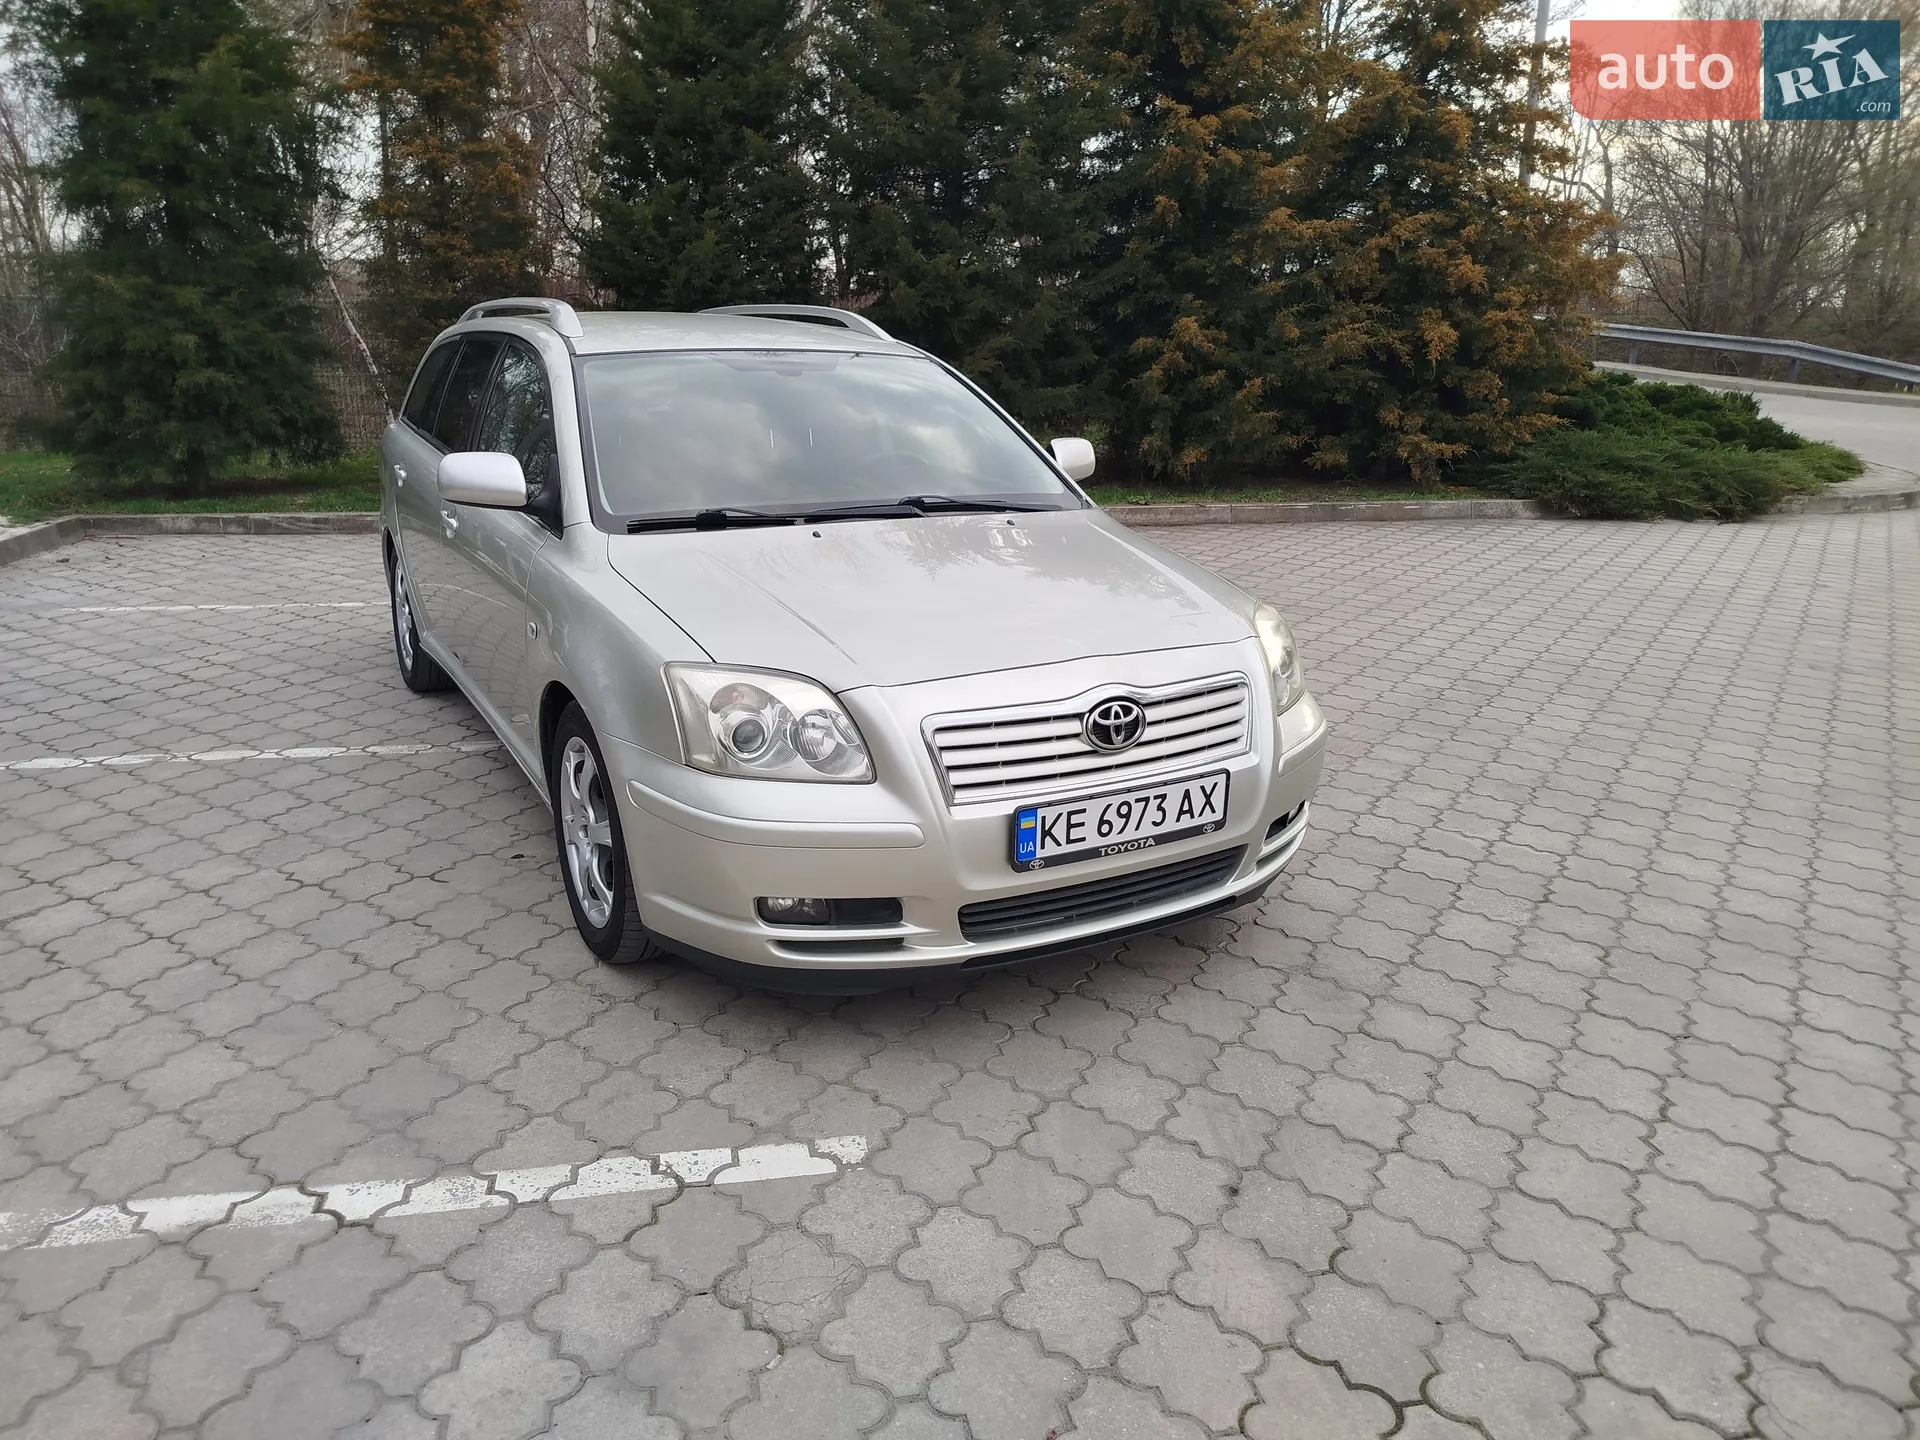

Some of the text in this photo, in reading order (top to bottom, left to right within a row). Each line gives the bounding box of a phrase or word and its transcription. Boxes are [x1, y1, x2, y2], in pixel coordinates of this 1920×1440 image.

[1040, 781, 1219, 850] KE 6973 AX
[1019, 842, 1035, 854] UA
[1098, 838, 1156, 857] TOYOTA
